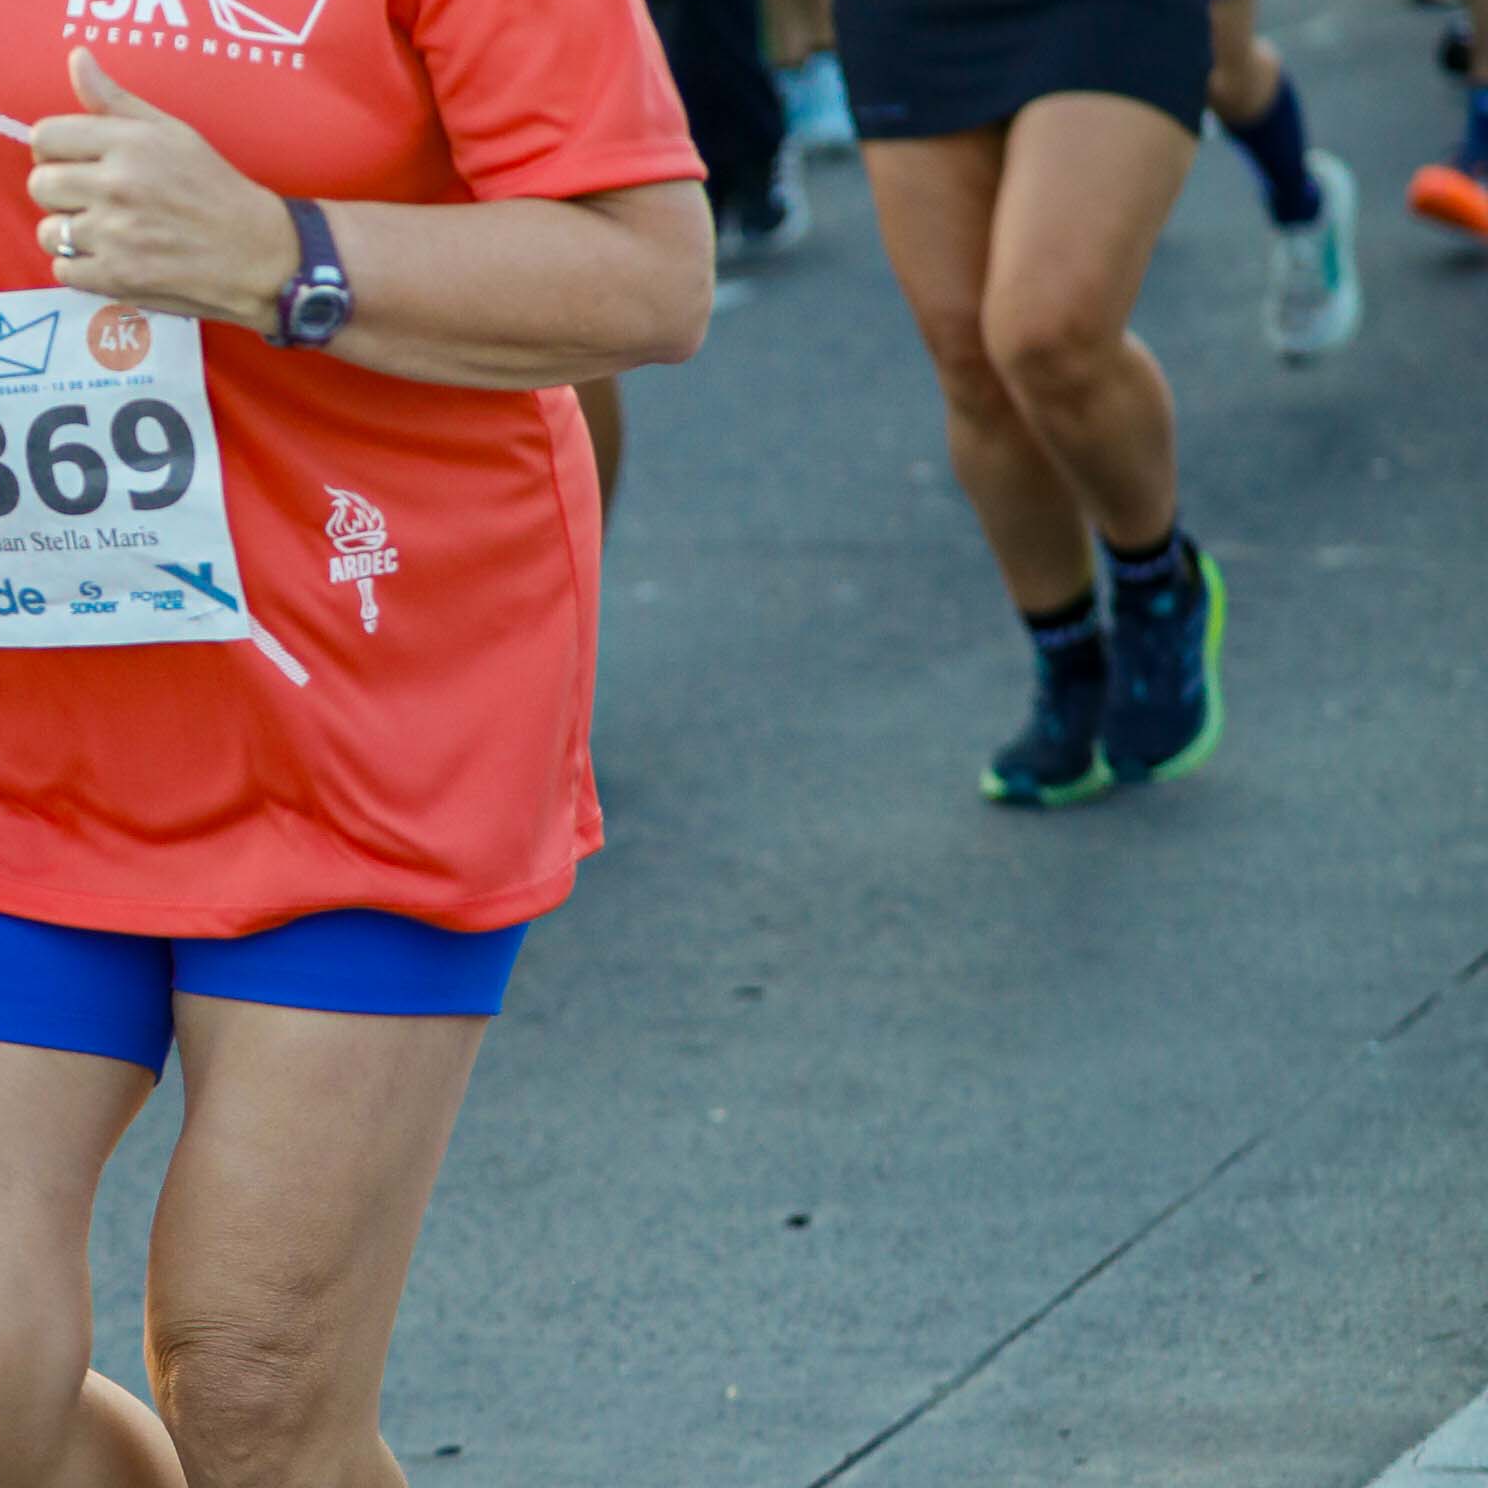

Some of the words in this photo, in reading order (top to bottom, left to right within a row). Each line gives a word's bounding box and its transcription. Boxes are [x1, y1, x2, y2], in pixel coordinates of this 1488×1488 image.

[62, 23, 189, 50] PUERTO
[202, 38, 305, 70] NORTE
[99, 323, 140, 352] 4K
[31, 530, 92, 553] Stella
[97, 526, 160, 550] Maris
[329, 547, 398, 584] ARDEC
